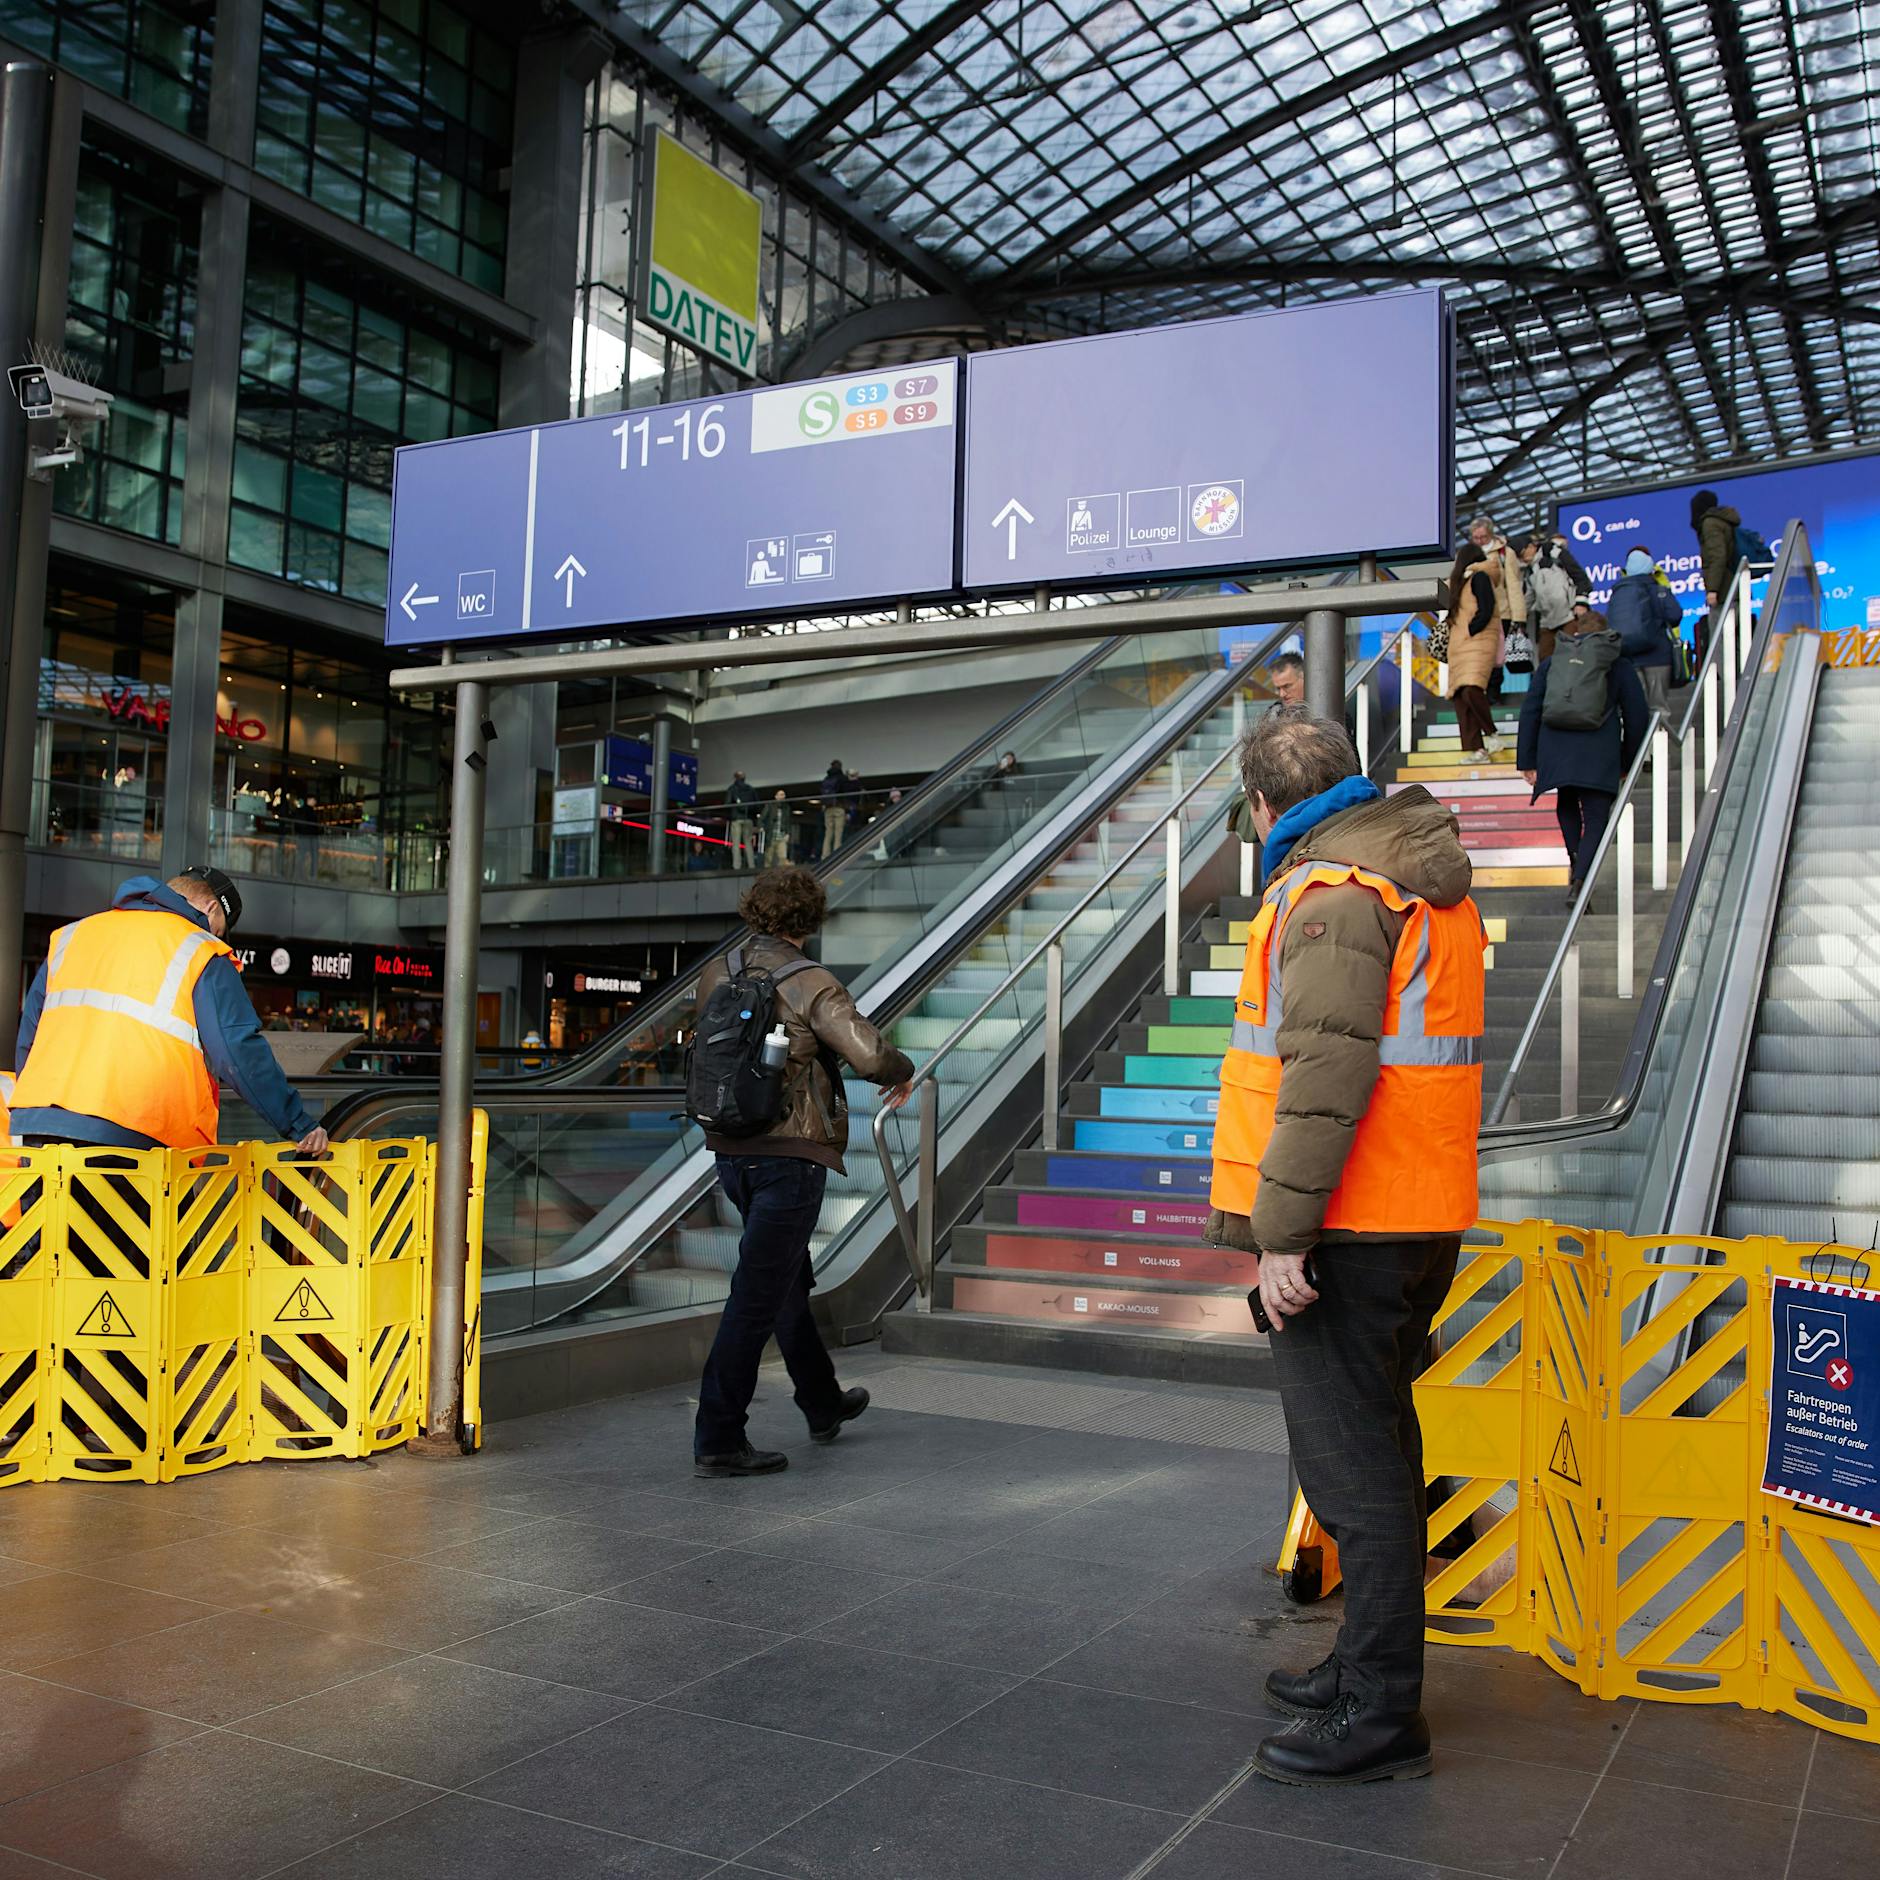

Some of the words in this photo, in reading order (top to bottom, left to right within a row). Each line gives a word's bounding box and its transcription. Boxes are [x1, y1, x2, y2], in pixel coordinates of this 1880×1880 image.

[650, 271, 756, 368] DATEV
[612, 403, 726, 471] 11-16
[1208, 508, 1236, 532] MISSION
[1605, 521, 1625, 532] can
[1625, 518, 1640, 529] do
[1070, 530, 1110, 547] Polizei
[1130, 526, 1177, 541] Lounge
[460, 593, 486, 613] WC
[585, 976, 620, 992] BURGER
[620, 980, 641, 993] KING
[1156, 1214, 1196, 1224] HALBBITTER
[1138, 1256, 1181, 1268] VOLL-NUSS
[1097, 1302, 1160, 1315] KAKAO-MOUSSE
[1787, 1389, 1852, 1415] Fahrtreppen
[1786, 1407, 1817, 1422] außer
[1818, 1412, 1858, 1432] Betrieb
[1785, 1422, 1823, 1440] Escalators
[1824, 1433, 1838, 1444] out
[1837, 1436, 1848, 1447] of
[1847, 1440, 1869, 1451] order
